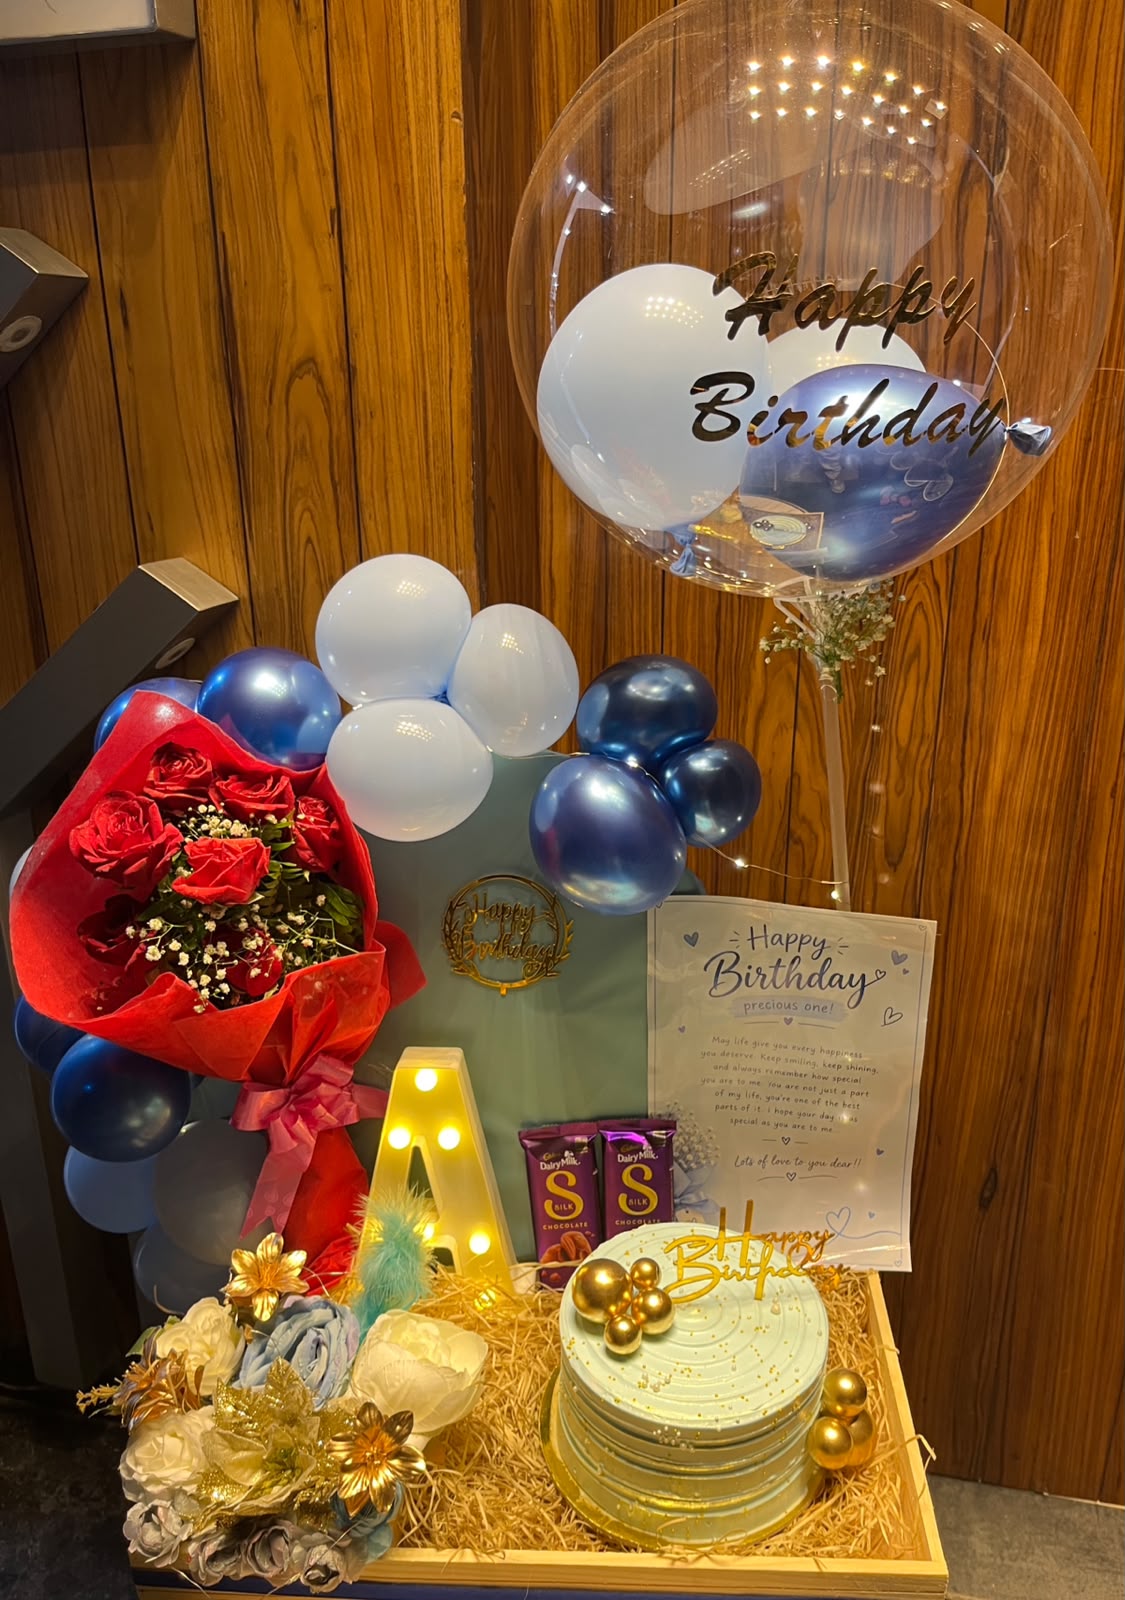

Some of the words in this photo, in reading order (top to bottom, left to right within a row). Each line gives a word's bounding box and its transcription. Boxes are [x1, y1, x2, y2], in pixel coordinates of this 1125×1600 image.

[712, 250, 977, 352] Happy
[690, 371, 1005, 458] Birthday
[464, 892, 536, 936] Happy
[747, 924, 831, 961] Happy
[453, 931, 556, 978] Birthday
[703, 950, 868, 1010] Birthday
[743, 1000, 798, 1015] precious
[804, 1002, 834, 1014] one!
[711, 1036, 730, 1047] May
[734, 1037, 749, 1045] life
[752, 1040, 769, 1049] give
[773, 1043, 788, 1051] you
[791, 1045, 816, 1055] every
[819, 1046, 863, 1059] happiness
[700, 1051, 717, 1059] you
[760, 1054, 781, 1064] Keep
[822, 1061, 842, 1071] keep
[732, 1063, 761, 1075] always
[765, 1069, 808, 1078] remember
[811, 1072, 829, 1081] how
[832, 1076, 862, 1084] special
[700, 1077, 716, 1086] you
[768, 1081, 782, 1089] You
[818, 1088, 837, 1096] just
[849, 1090, 869, 1098] part
[714, 1089, 725, 1097] of
[728, 1092, 741, 1100] my
[765, 1094, 791, 1102] you're
[811, 1097, 822, 1105] of
[825, 1100, 839, 1108] the
[842, 1100, 861, 1109] best
[714, 1104, 738, 1112] parts
[740, 1103, 751, 1112] of
[774, 1106, 793, 1117] hope
[797, 1111, 816, 1119] your
[819, 1112, 835, 1122] day
[729, 1117, 758, 1126] special
[773, 1121, 789, 1130] you
[540, 1161, 561, 1171] Dairy
[617, 1153, 639, 1163] Dairy
[734, 1155, 754, 1168] Lots
[757, 1154, 769, 1169] of
[770, 1154, 792, 1166] love
[794, 1156, 804, 1166] to
[807, 1160, 828, 1171] you
[829, 1157, 862, 1169] dear!!
[357, 1047, 520, 1298] A
[544, 1170, 584, 1220] S
[618, 1163, 659, 1216] S
[554, 1203, 575, 1212] SILK
[628, 1198, 648, 1206] SILK
[542, 1221, 588, 1231] CHOCOLATE
[713, 1199, 835, 1268] Happy
